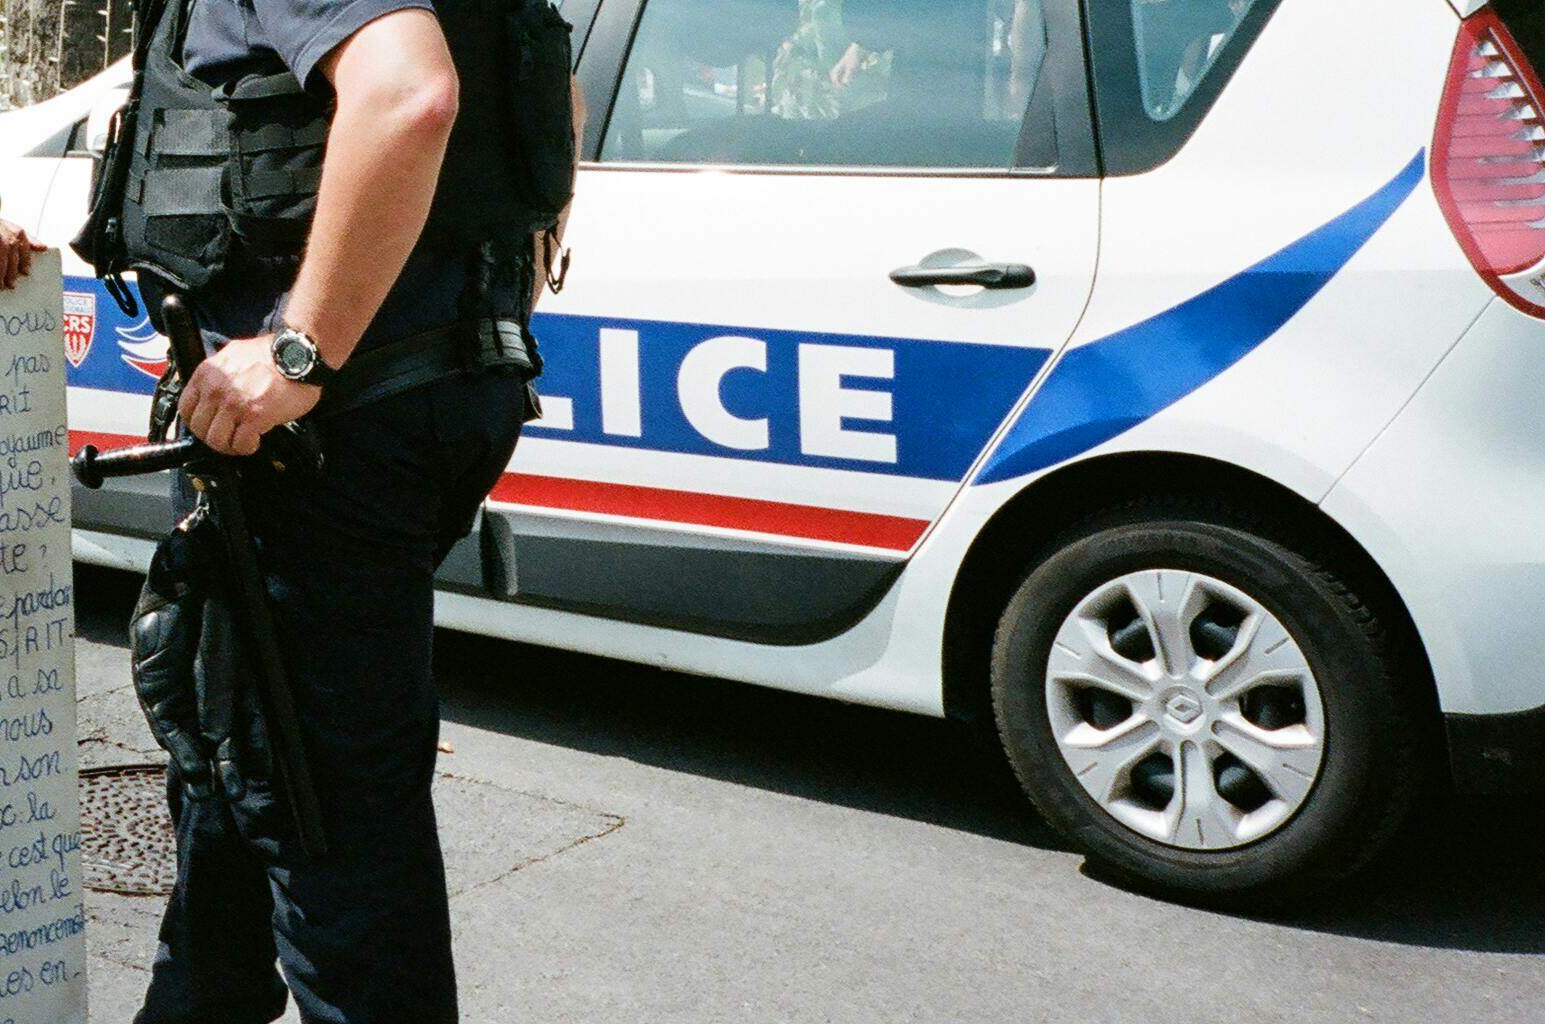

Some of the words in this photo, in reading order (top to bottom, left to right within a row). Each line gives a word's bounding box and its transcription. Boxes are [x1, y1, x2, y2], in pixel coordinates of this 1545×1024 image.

[5, 353, 51, 387] pas
[13, 749, 61, 784] son
[26, 791, 56, 825] la
[49, 867, 72, 901] le
